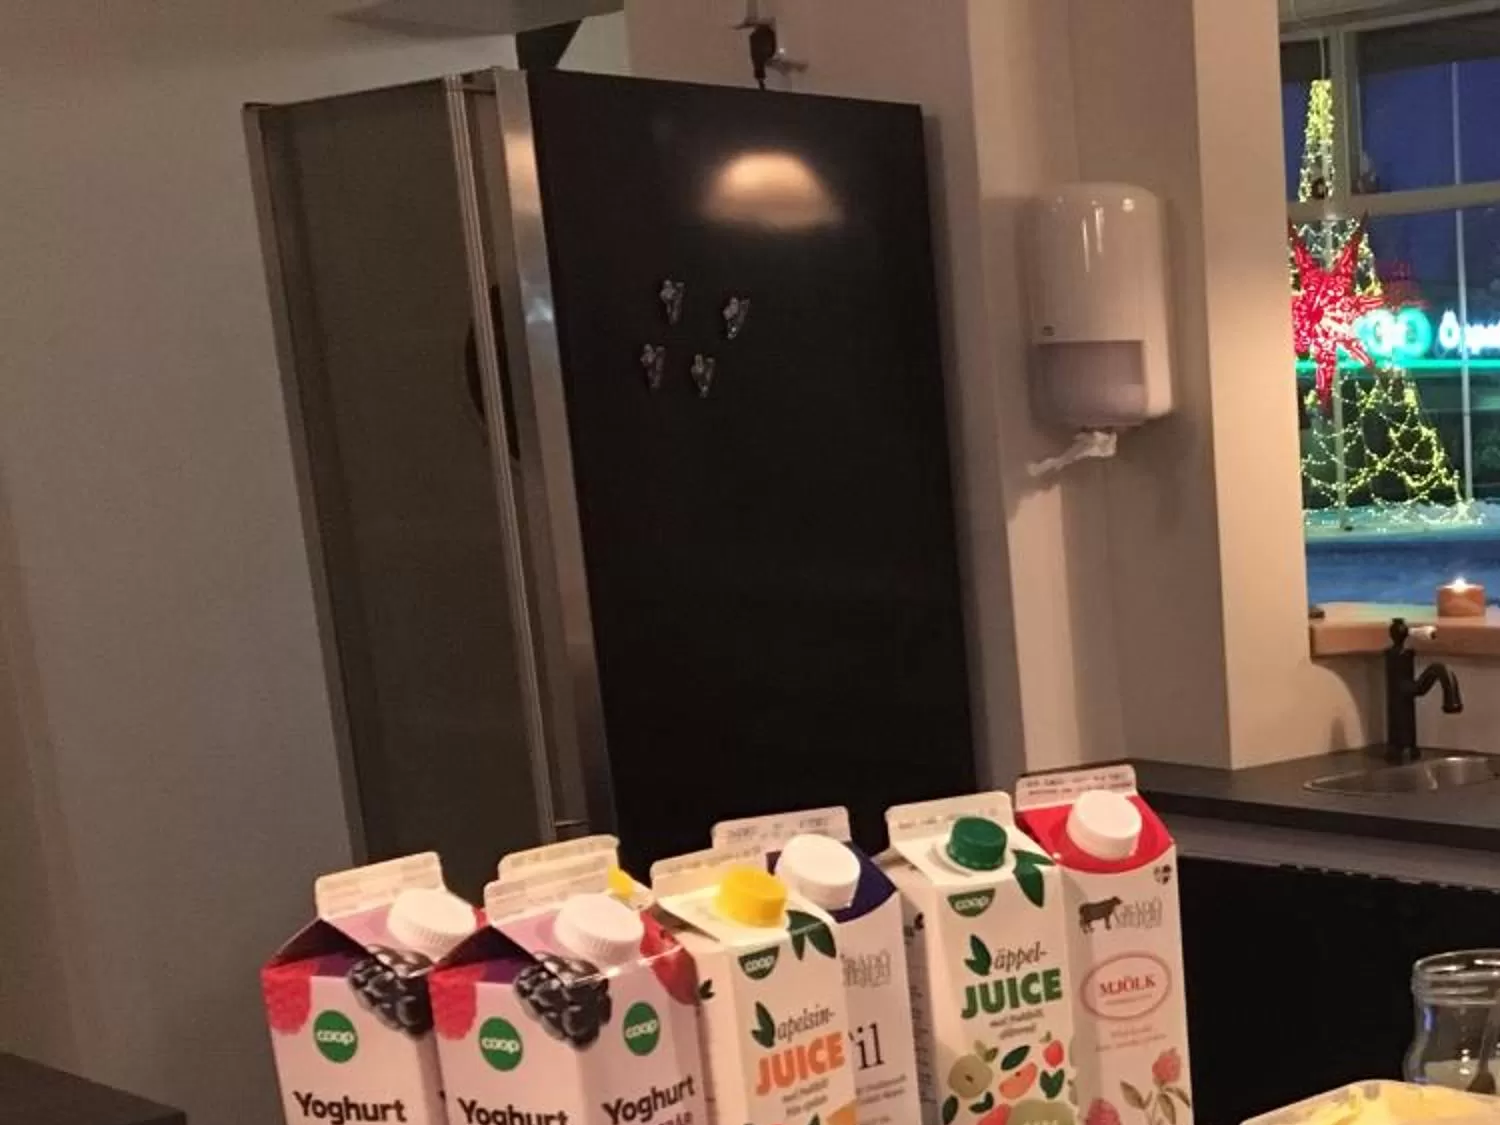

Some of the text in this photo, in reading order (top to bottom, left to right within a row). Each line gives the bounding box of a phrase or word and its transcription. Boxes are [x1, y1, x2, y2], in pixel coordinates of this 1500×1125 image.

[954, 895, 990, 912] coop
[744, 956, 775, 973] coop
[994, 941, 1049, 973] äppel-
[961, 967, 1063, 1020] JUICE
[1099, 975, 1156, 997] MJÖLK
[317, 1029, 355, 1047] coop
[625, 1019, 657, 1039] coop
[481, 1036, 520, 1054] coop
[848, 1021, 885, 1070] il
[756, 1031, 845, 1096] JUICE
